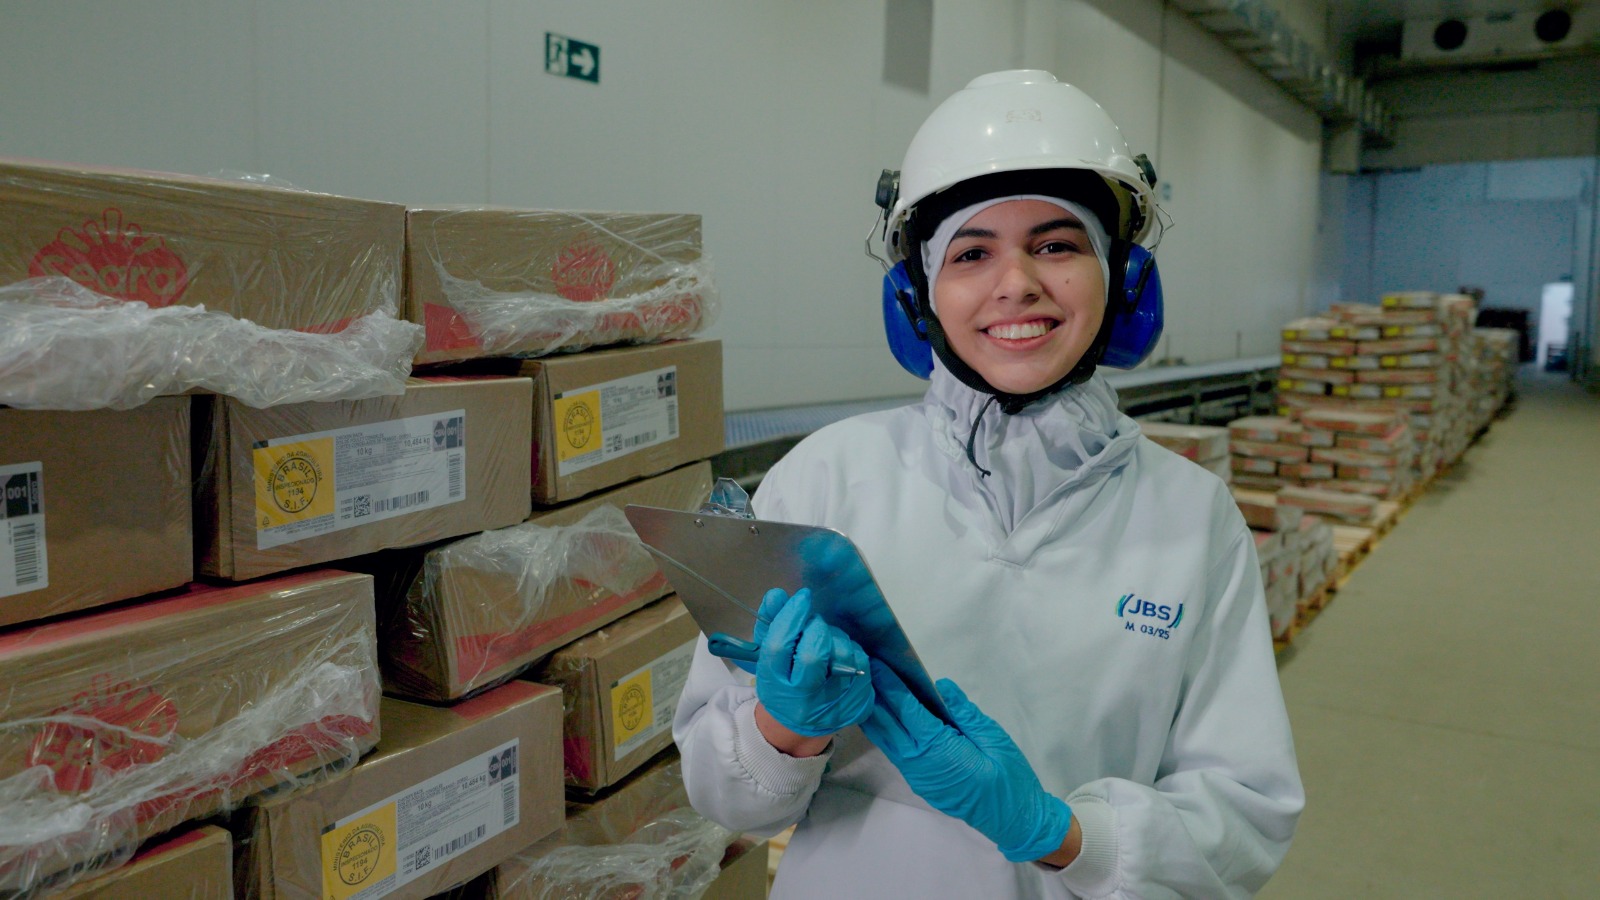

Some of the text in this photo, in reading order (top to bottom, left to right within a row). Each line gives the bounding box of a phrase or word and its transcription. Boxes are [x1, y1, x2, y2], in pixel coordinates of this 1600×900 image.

[356, 447, 364, 456] 10
[364, 446, 373, 455] kg
[278, 461, 312, 482] BRASIL
[7, 486, 27, 500] 001
[1128, 599, 1171, 621] JBS
[1125, 621, 1135, 631] M
[417, 801, 432, 811] 10 kg
[343, 833, 375, 859] BRASIL
[352, 857, 368, 870] 1194
